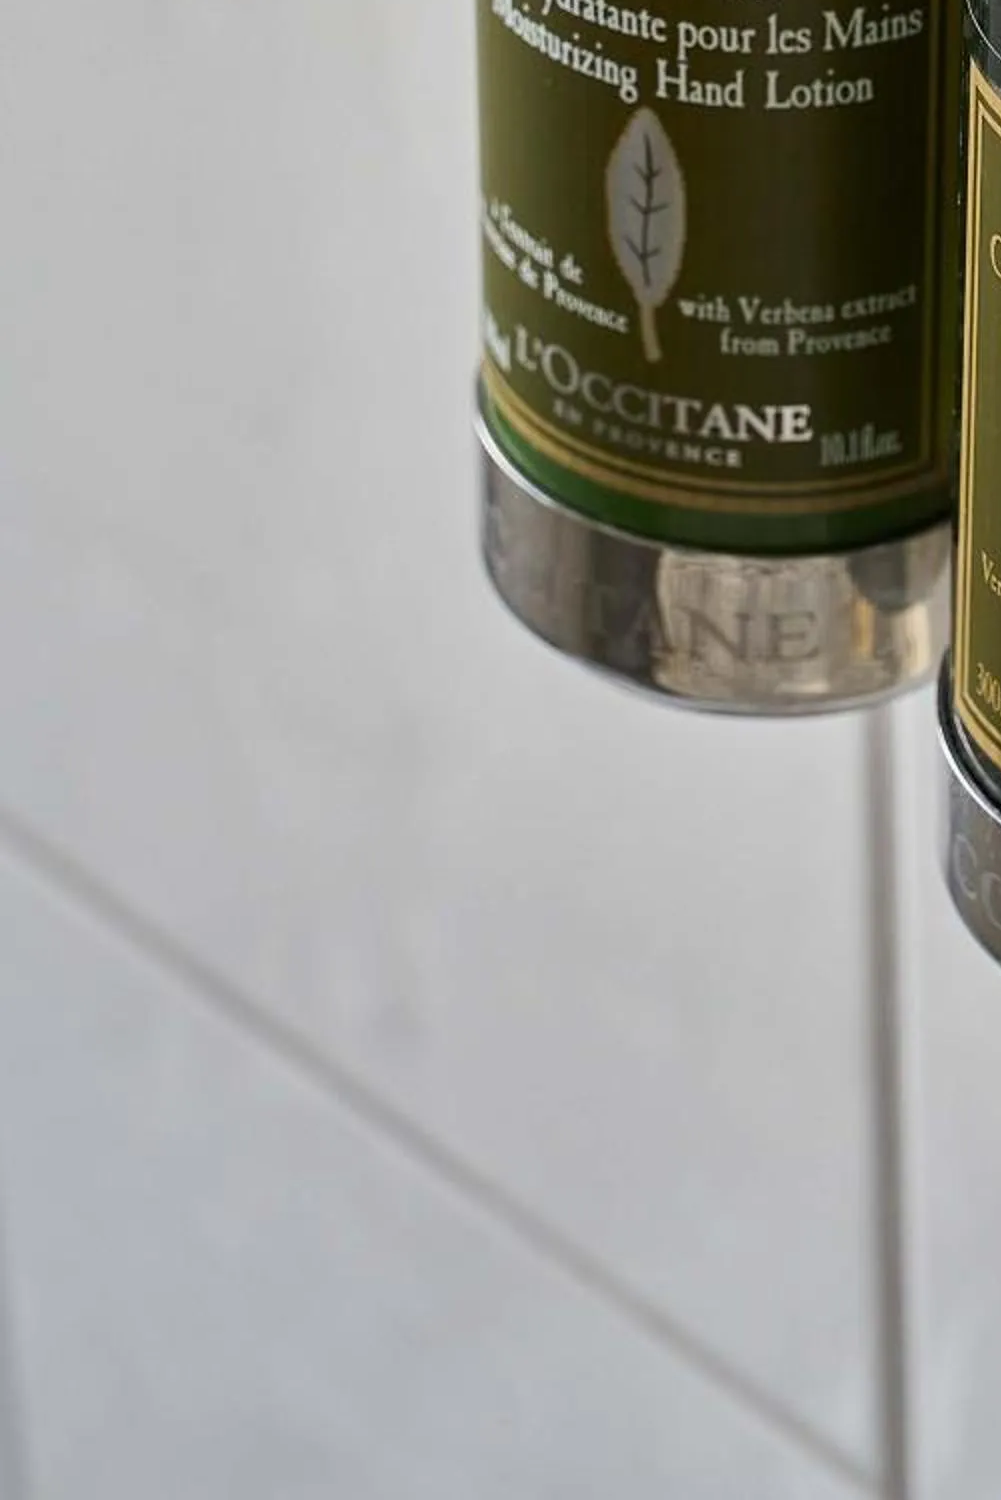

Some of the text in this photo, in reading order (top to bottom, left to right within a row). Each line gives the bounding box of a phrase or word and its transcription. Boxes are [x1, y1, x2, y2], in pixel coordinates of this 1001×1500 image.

[676, 20, 756, 60] pour
[766, 13, 812, 55] les
[821, 2, 925, 52] Mains
[655, 56, 745, 109] Hand
[764, 68, 875, 111] Lotion
[678, 285, 918, 326] with Verbena extract
[720, 325, 891, 356] from Provence
[593, 413, 743, 468] PROVENCE
